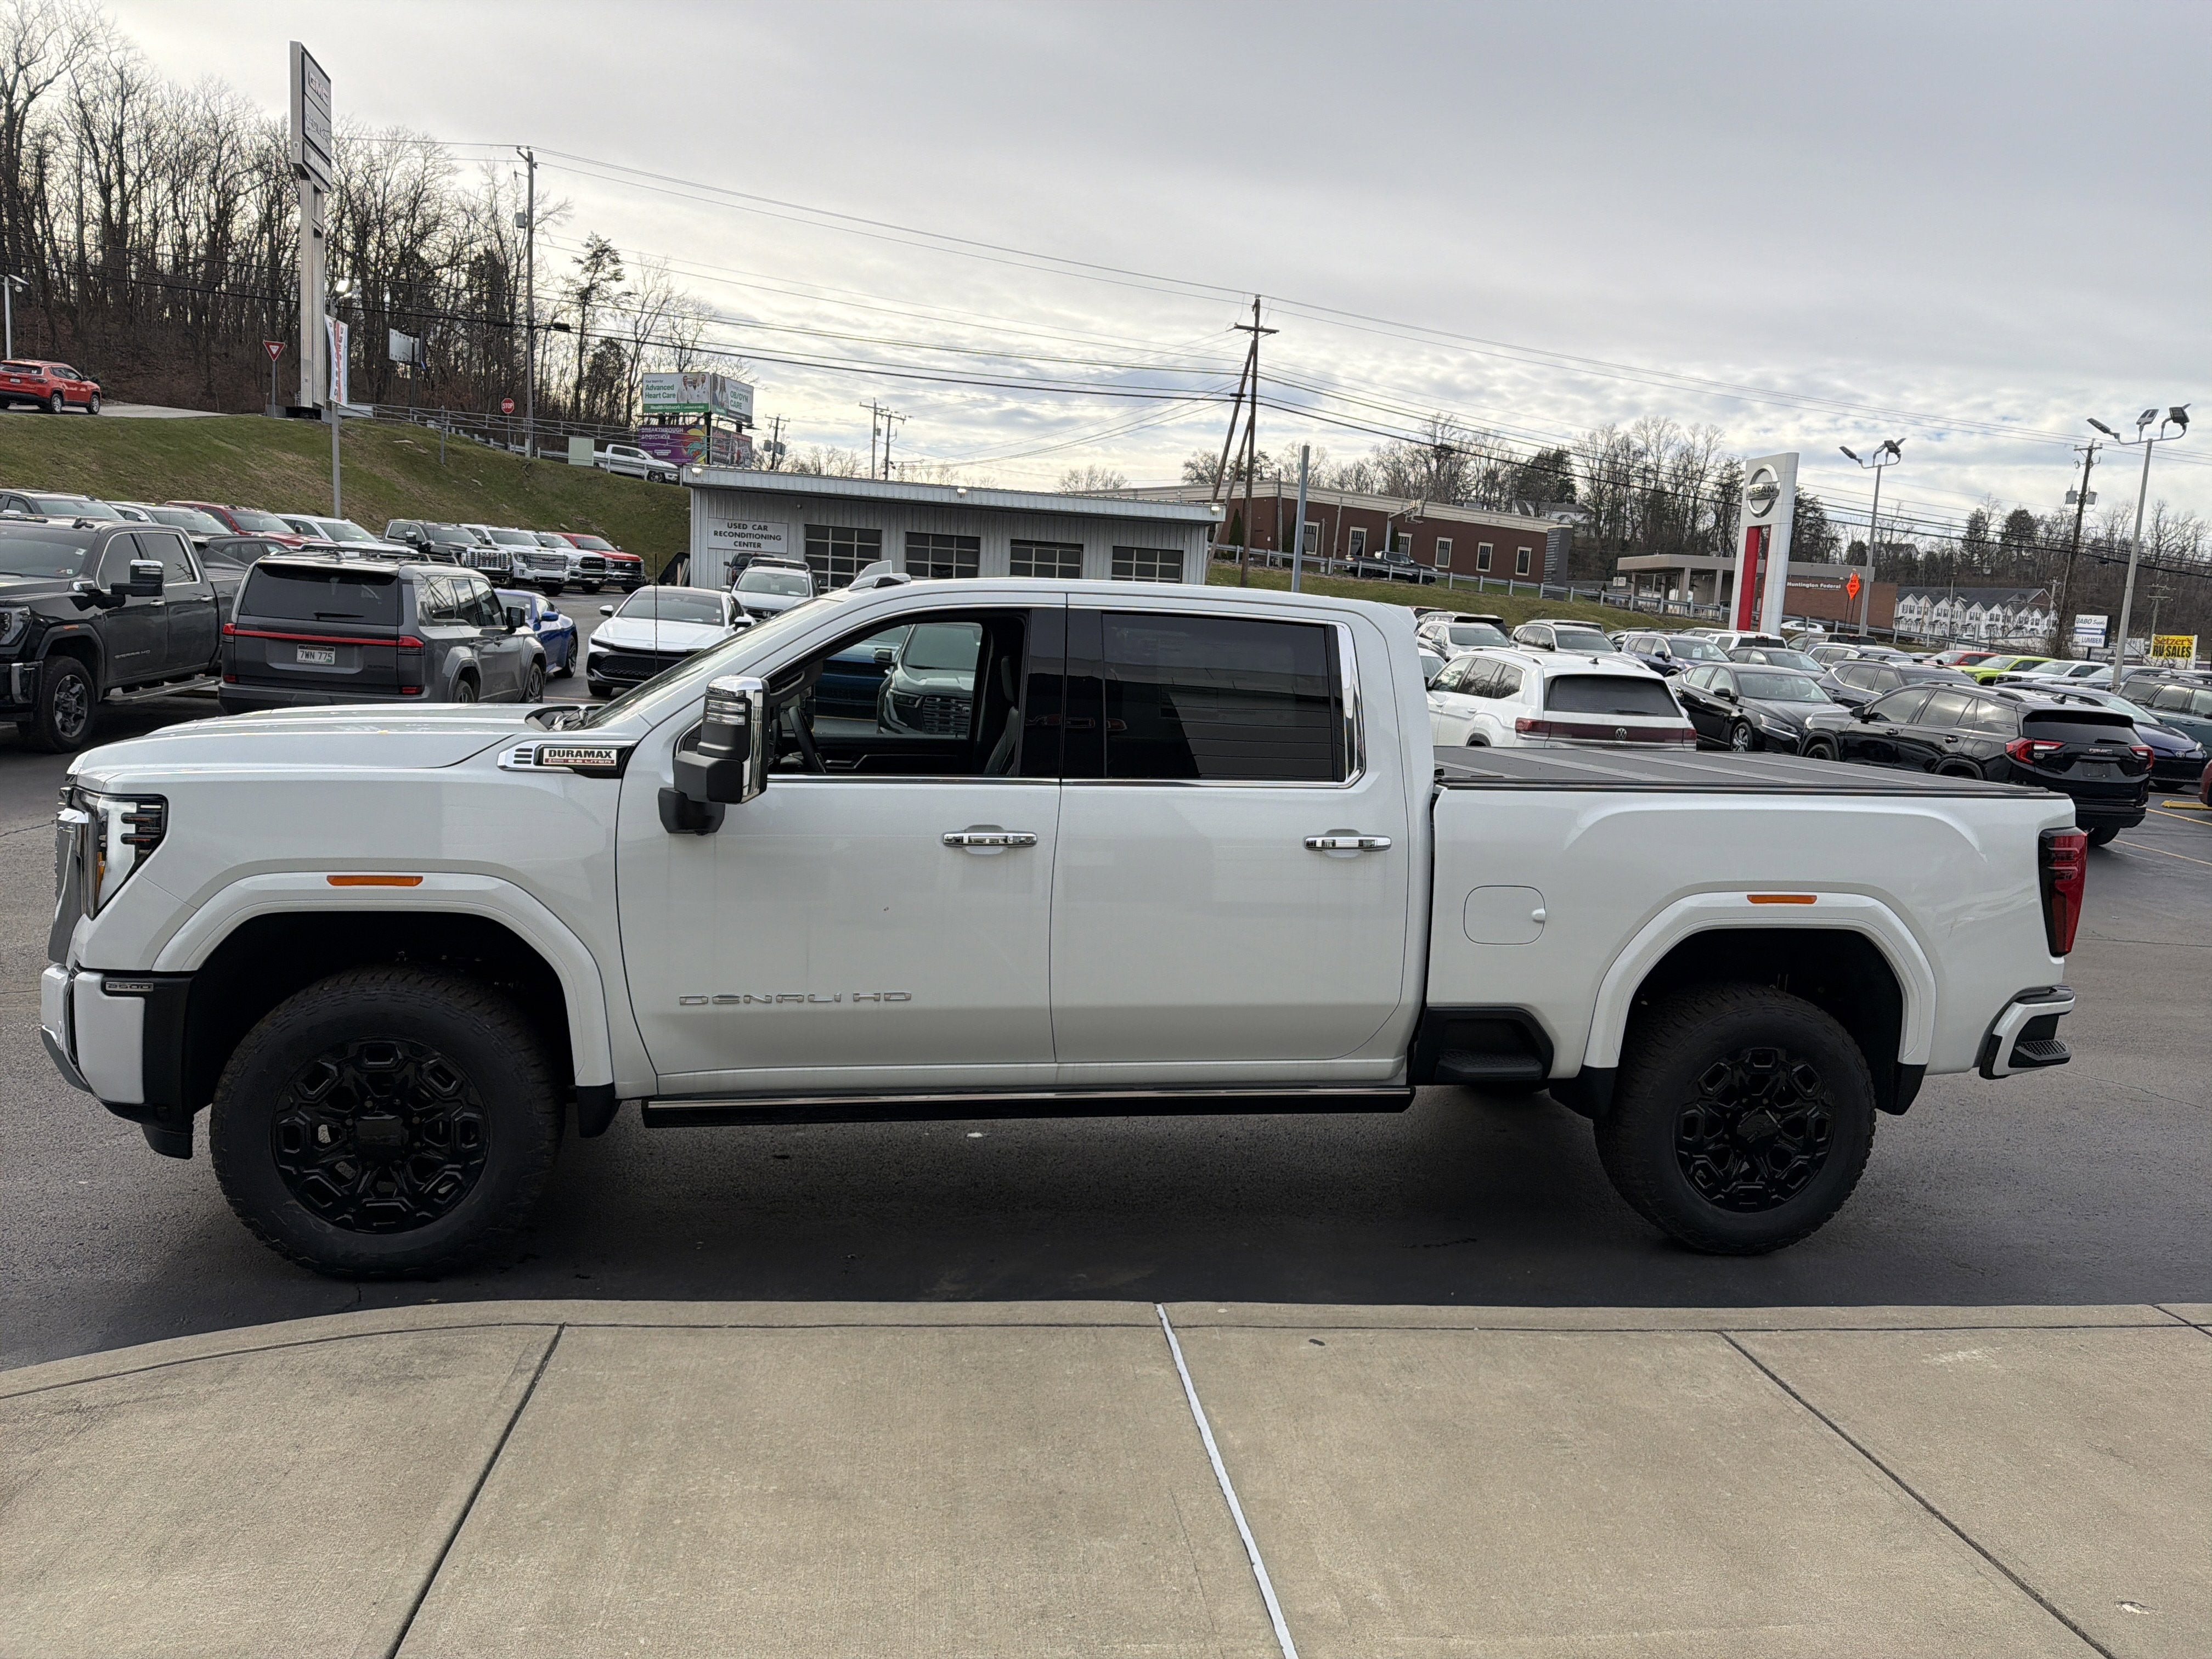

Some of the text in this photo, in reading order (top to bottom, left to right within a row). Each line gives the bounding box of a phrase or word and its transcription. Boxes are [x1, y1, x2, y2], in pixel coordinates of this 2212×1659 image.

[308, 71, 329, 106] GMC
[305, 111, 330, 146] CADILLAC
[730, 390, 748, 403] OB/GYN
[730, 399, 742, 410] CARE
[714, 531, 782, 541] RECONDITIONING
[733, 540, 762, 549] CENTER
[2153, 636, 2193, 645] Setzer's
[300, 650, 315, 659] 7WN
[318, 652, 334, 661] 775
[2153, 645, 2192, 658] RV SALES
[549, 749, 612, 758] DURAMAX
[679, 991, 912, 1005] DENALI HD
